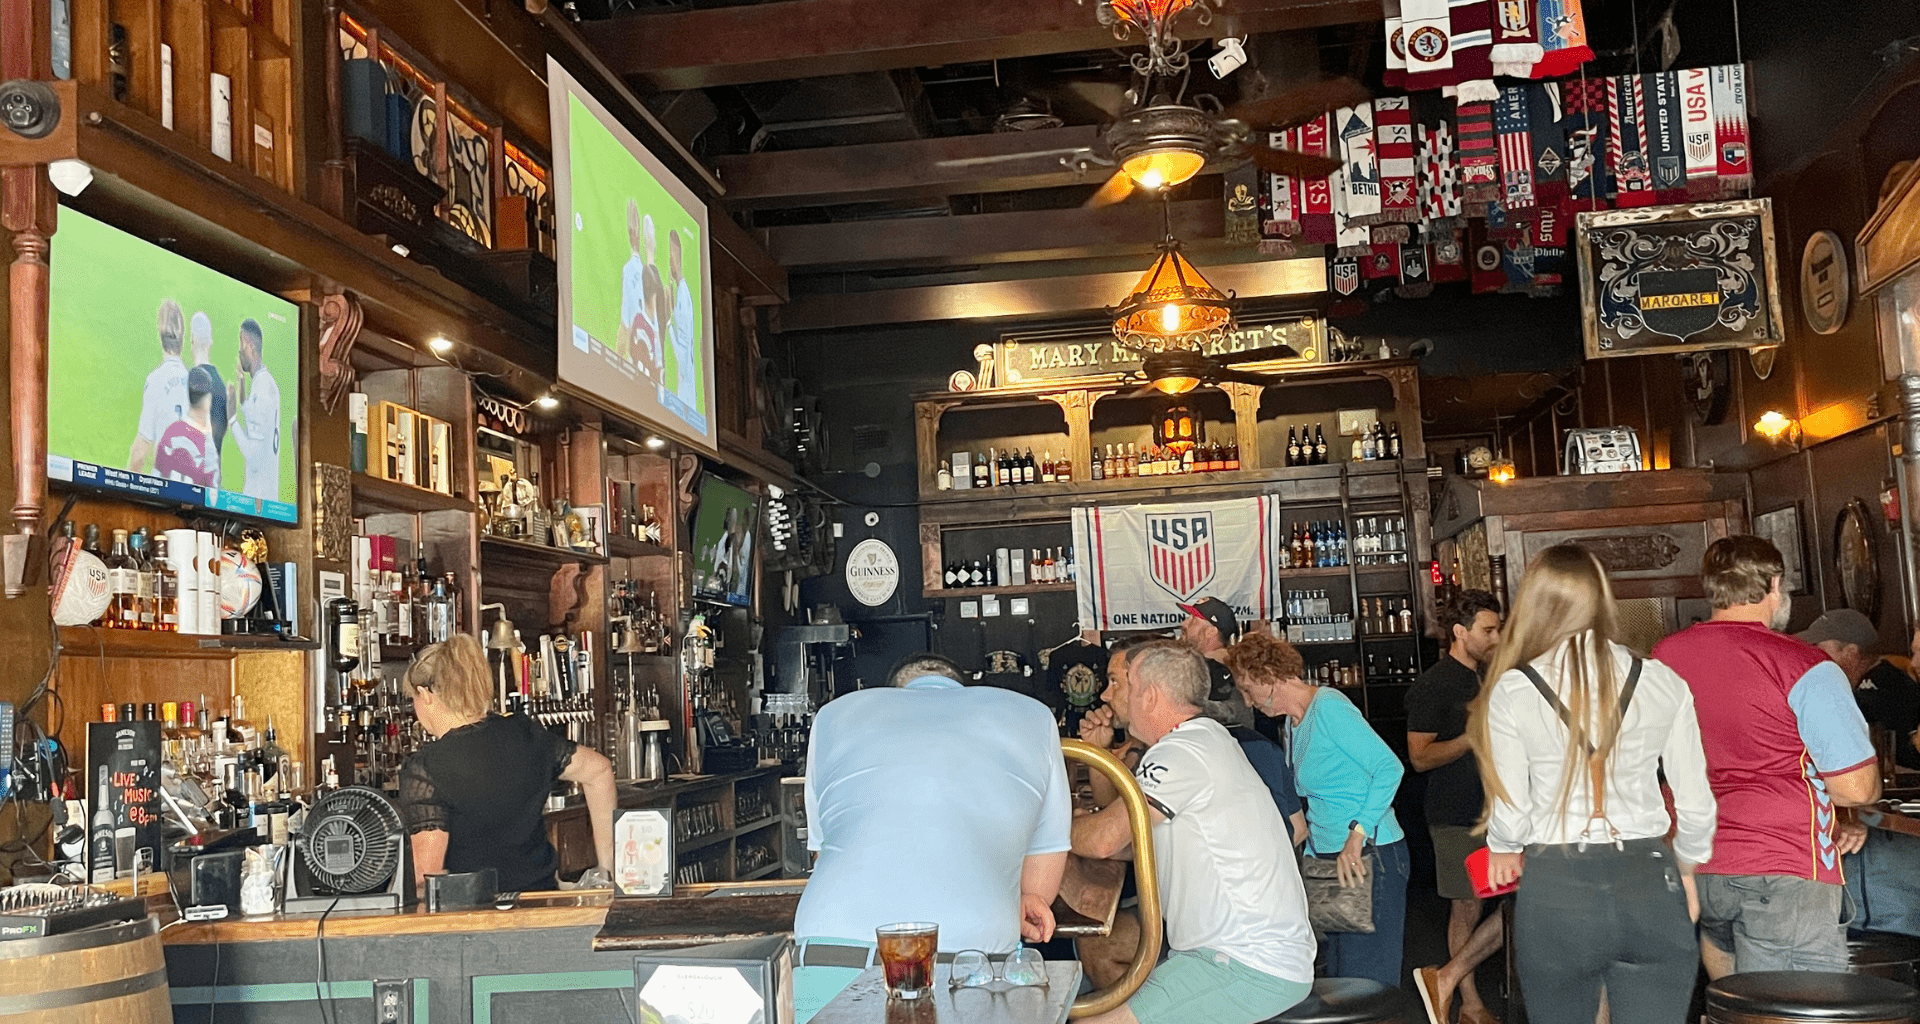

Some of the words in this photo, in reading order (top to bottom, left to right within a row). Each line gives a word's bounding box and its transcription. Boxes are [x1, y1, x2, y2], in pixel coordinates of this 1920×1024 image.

[1409, 27, 1427, 45] ASTON
[1623, 74, 1635, 124] American
[1686, 83, 1708, 122] USA
[1659, 108, 1671, 152] UNITED
[1689, 133, 1709, 145] USA
[1335, 265, 1356, 278] USA
[1029, 343, 1104, 370] MARY
[1151, 517, 1208, 550] USA
[89, 568, 107, 581] USA
[850, 566, 896, 577] GUINNESS
[1113, 613, 1138, 625] ONE
[1141, 612, 1186, 624] NATION
[113, 771, 136, 788] LIVE
[123, 788, 153, 804] MUSIC
